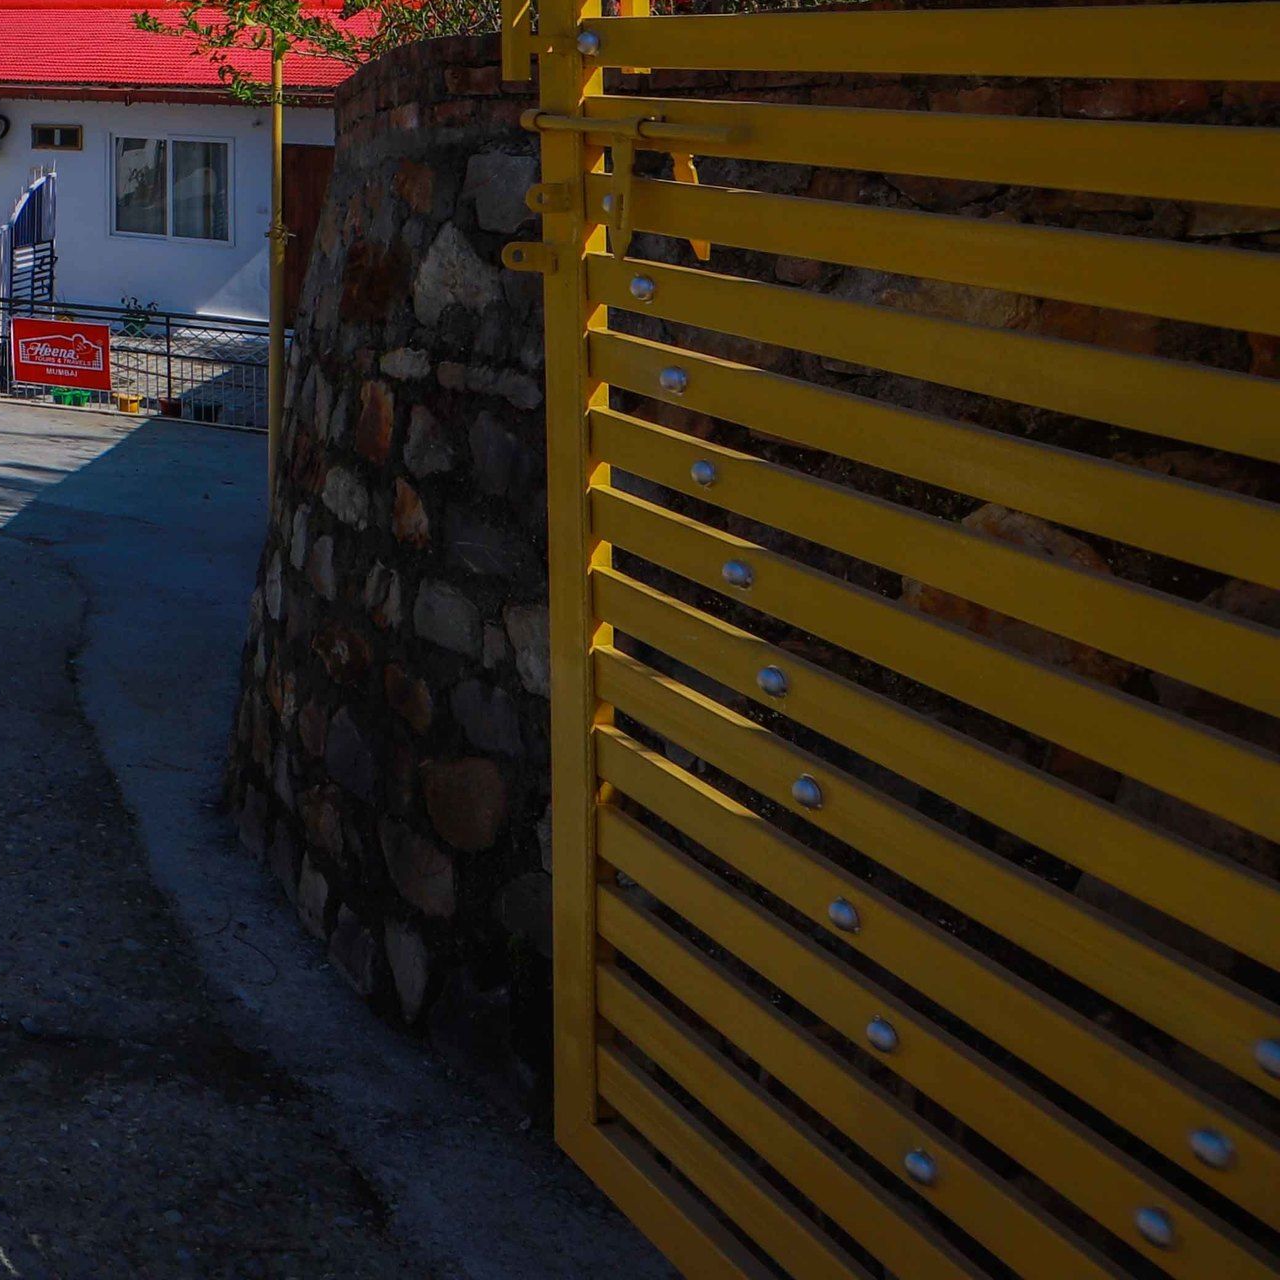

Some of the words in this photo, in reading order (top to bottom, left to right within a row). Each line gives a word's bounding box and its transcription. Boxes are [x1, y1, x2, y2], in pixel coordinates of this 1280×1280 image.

[27, 342, 79, 359] Heena
[34, 355, 56, 363] TOURS
[63, 358, 92, 366] TRAVELS
[45, 367, 78, 377] MUMBAI
